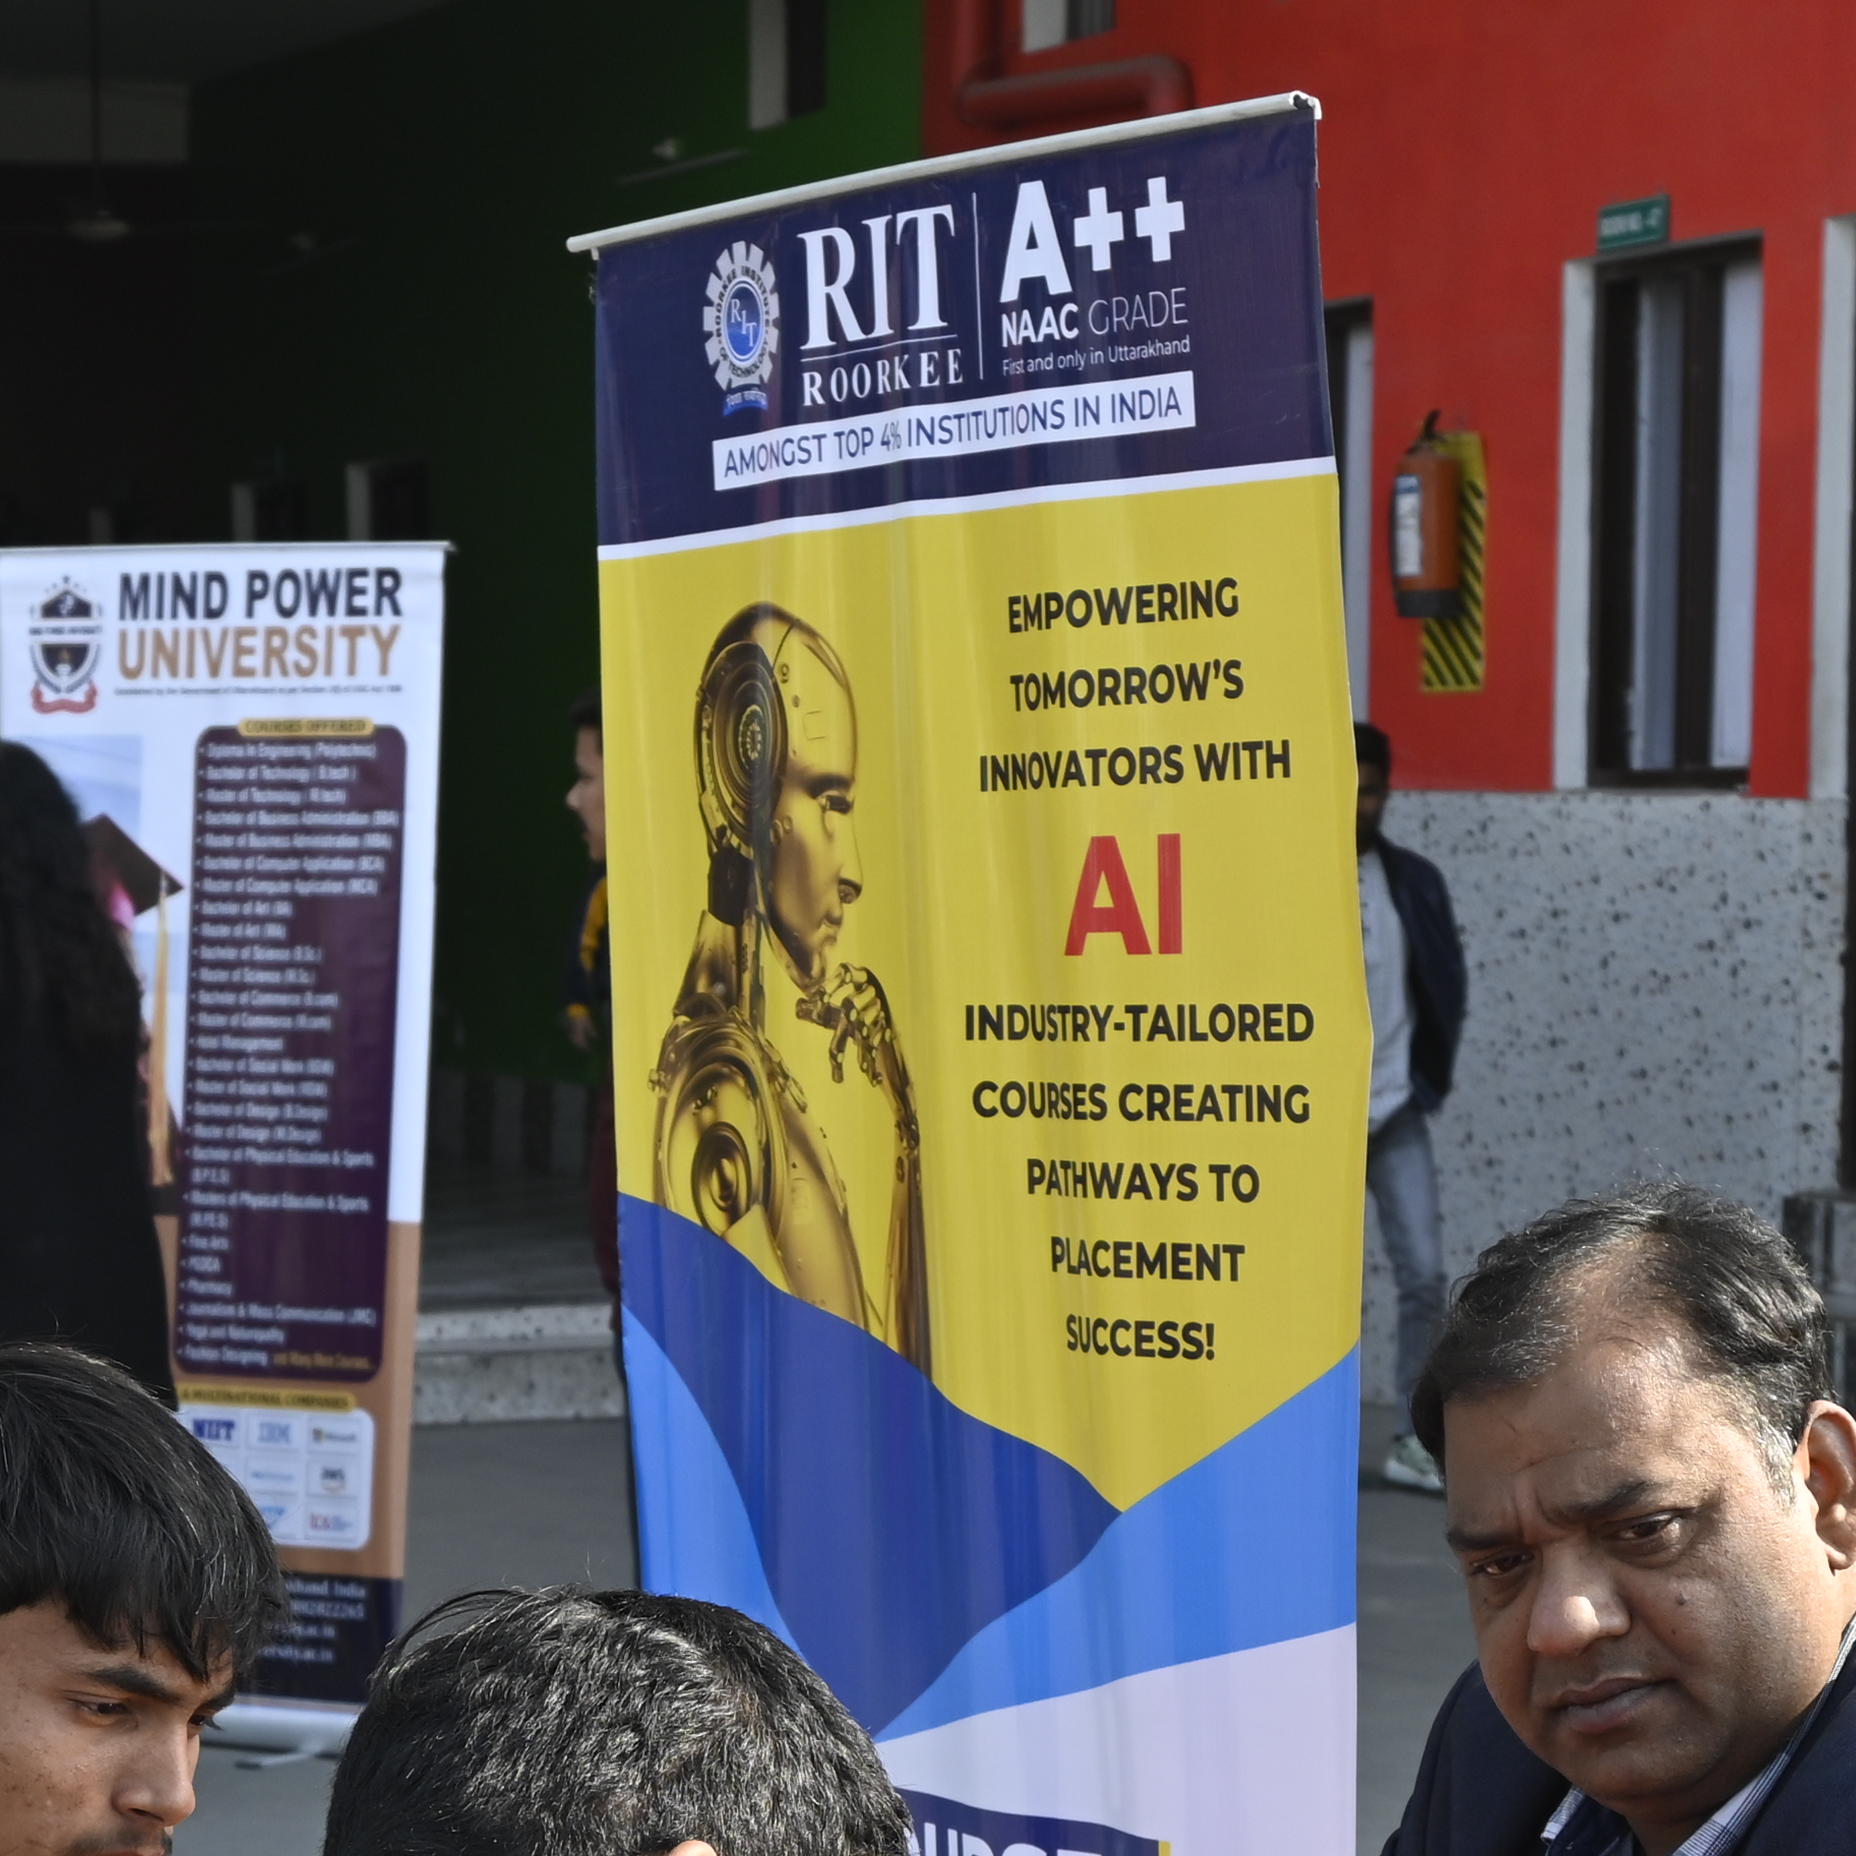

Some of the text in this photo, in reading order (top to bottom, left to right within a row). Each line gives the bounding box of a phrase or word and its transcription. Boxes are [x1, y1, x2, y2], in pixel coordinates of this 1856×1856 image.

[1000, 176, 1185, 303] A++
[797, 204, 955, 350] RIT
[1000, 286, 1189, 348] NAAC GRADE
[803, 348, 965, 407] ROORKEE
[1002, 335, 1191, 378] First and only in Uttarakhand
[724, 385, 1183, 479] AMONGST TOP 4% INSTITUTIONS IN INDIA
[118, 567, 403, 621] MIND POWER
[1008, 577, 1240, 633] EMPOWERING
[118, 625, 400, 681] UNIVERSITY
[1009, 658, 1245, 712] TOMORROW'S
[979, 739, 1291, 792] INNOVATORS WITH
[1064, 833, 1183, 957] AI
[965, 1003, 1315, 1042] INDUSTRY-TAILORED
[972, 1080, 1311, 1124] COURSES CREATING
[1027, 1158, 1260, 1203] PATHWAYS TO
[1050, 1236, 1246, 1282] PLACEMENT
[1066, 1313, 1215, 1361] SUCCESS!
